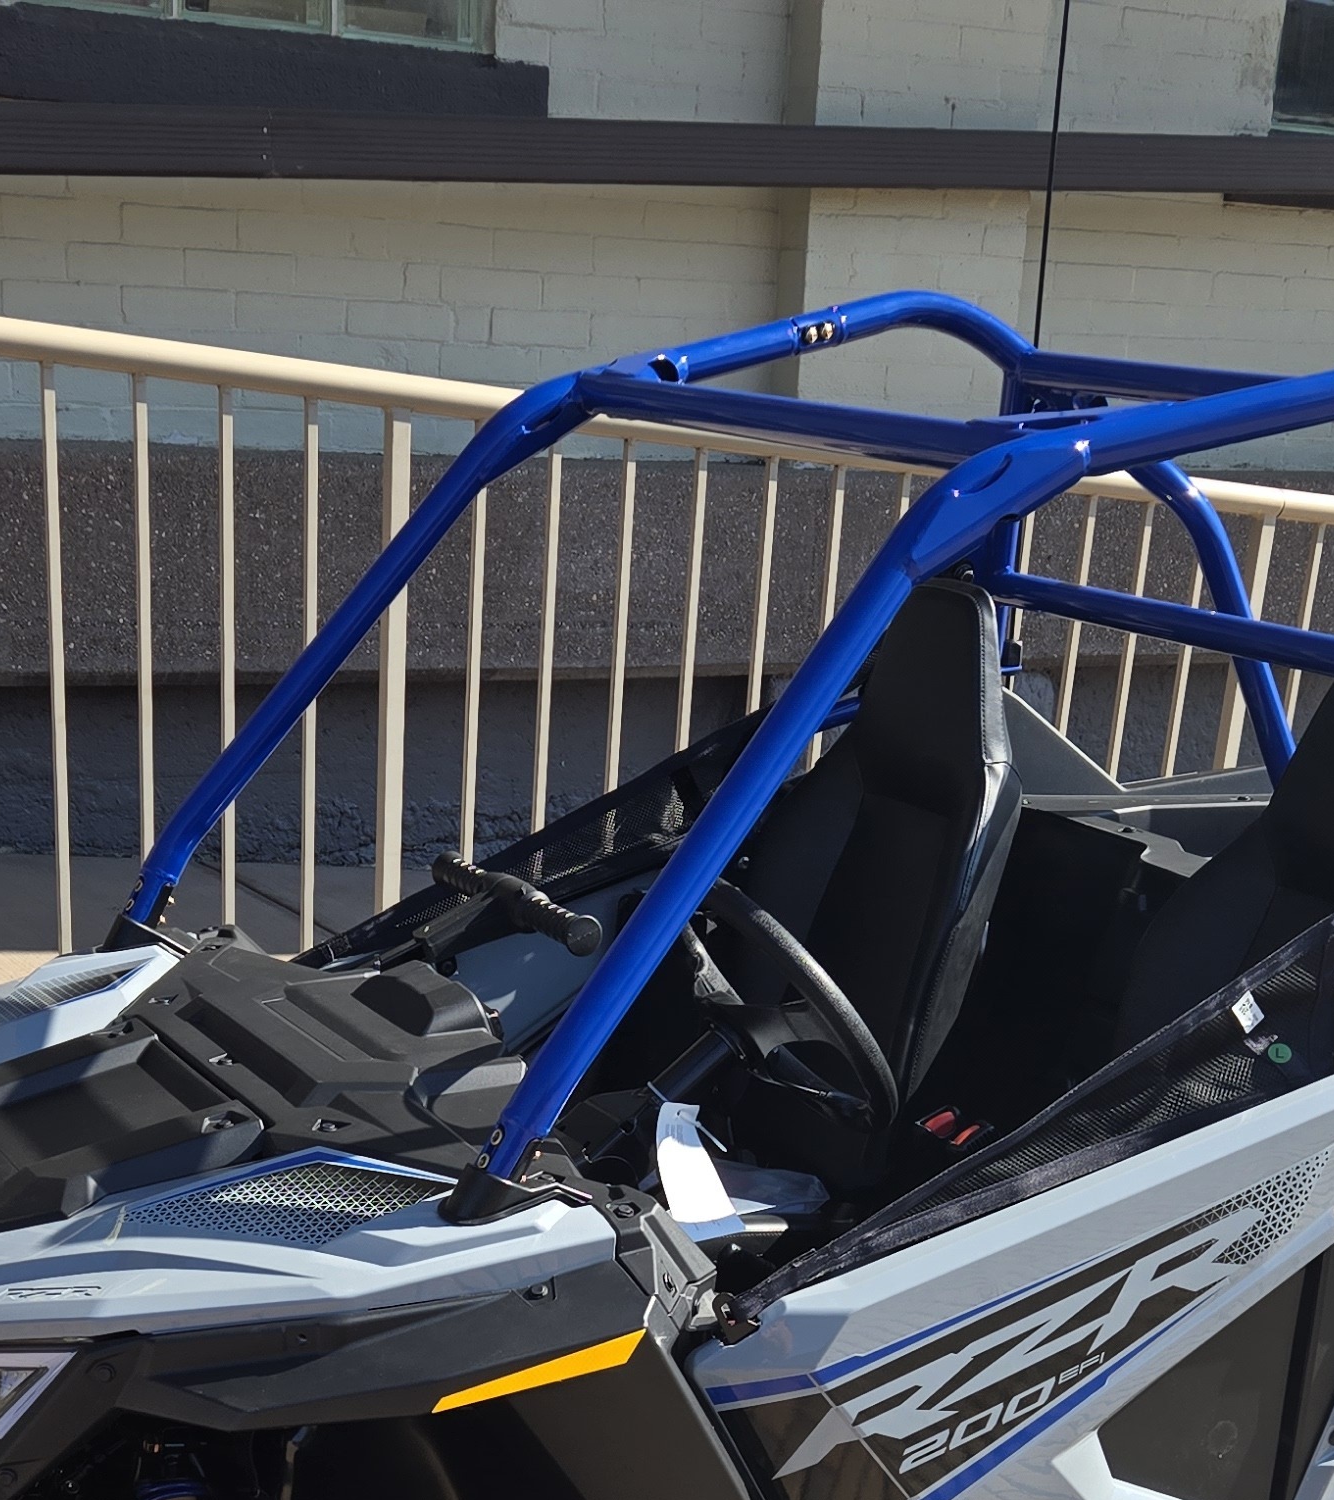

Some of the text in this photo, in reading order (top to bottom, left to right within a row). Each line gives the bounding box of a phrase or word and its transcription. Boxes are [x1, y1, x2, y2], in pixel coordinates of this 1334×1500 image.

[1275, 1048, 1284, 1059] L
[771, 1204, 1267, 1480] RZR
[898, 1351, 1107, 1475] 200 EFI
